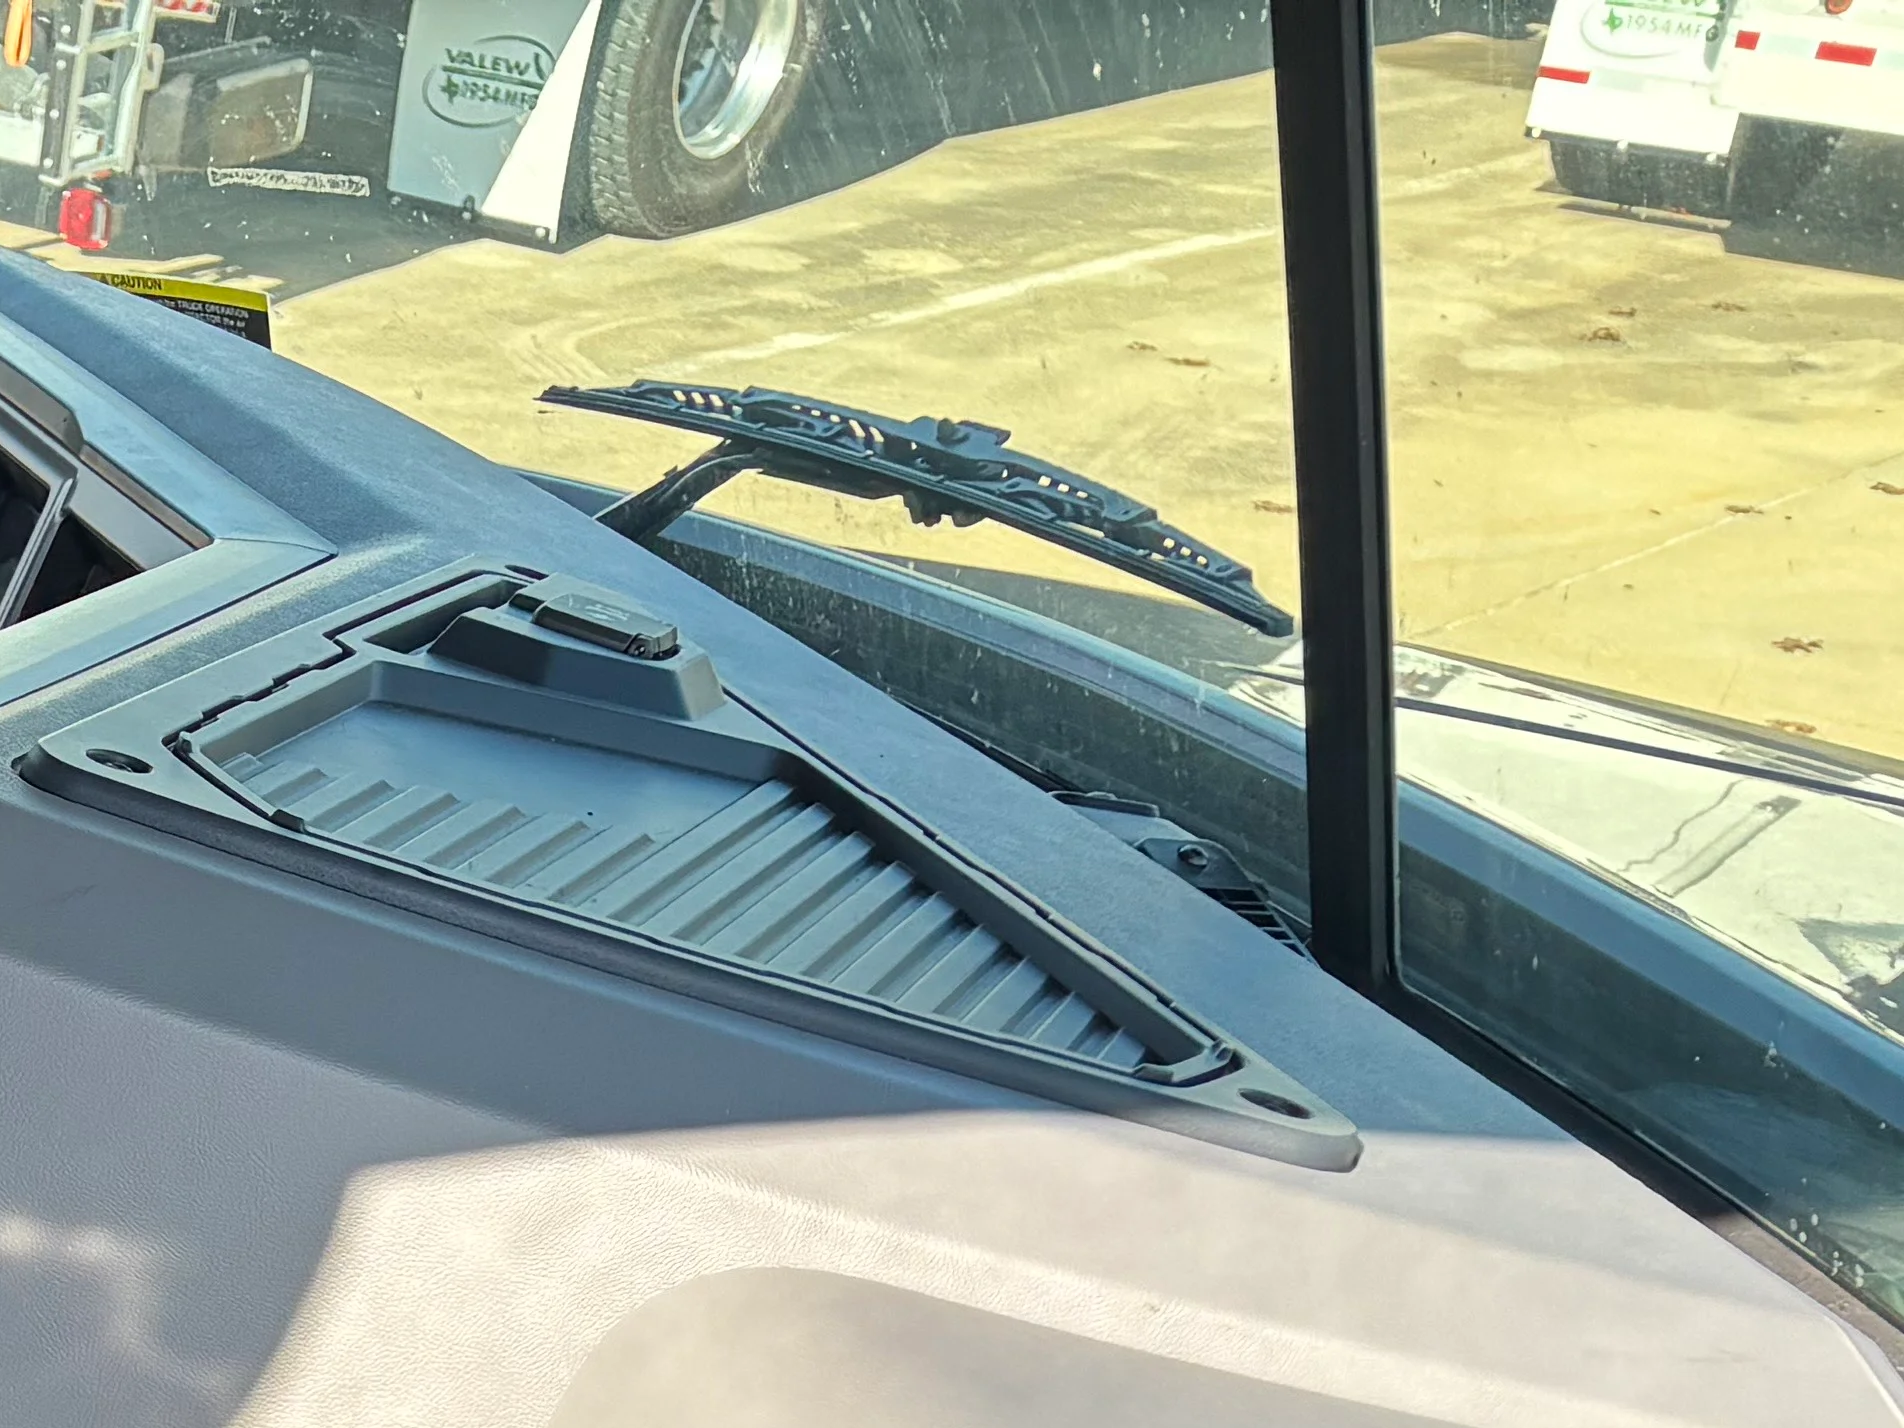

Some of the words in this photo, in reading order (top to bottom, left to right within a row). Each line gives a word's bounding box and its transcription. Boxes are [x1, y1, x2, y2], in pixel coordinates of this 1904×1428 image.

[444, 48, 531, 76] VALEW
[111, 274, 162, 291] CAUTION
[204, 302, 249, 319] OPERATION
